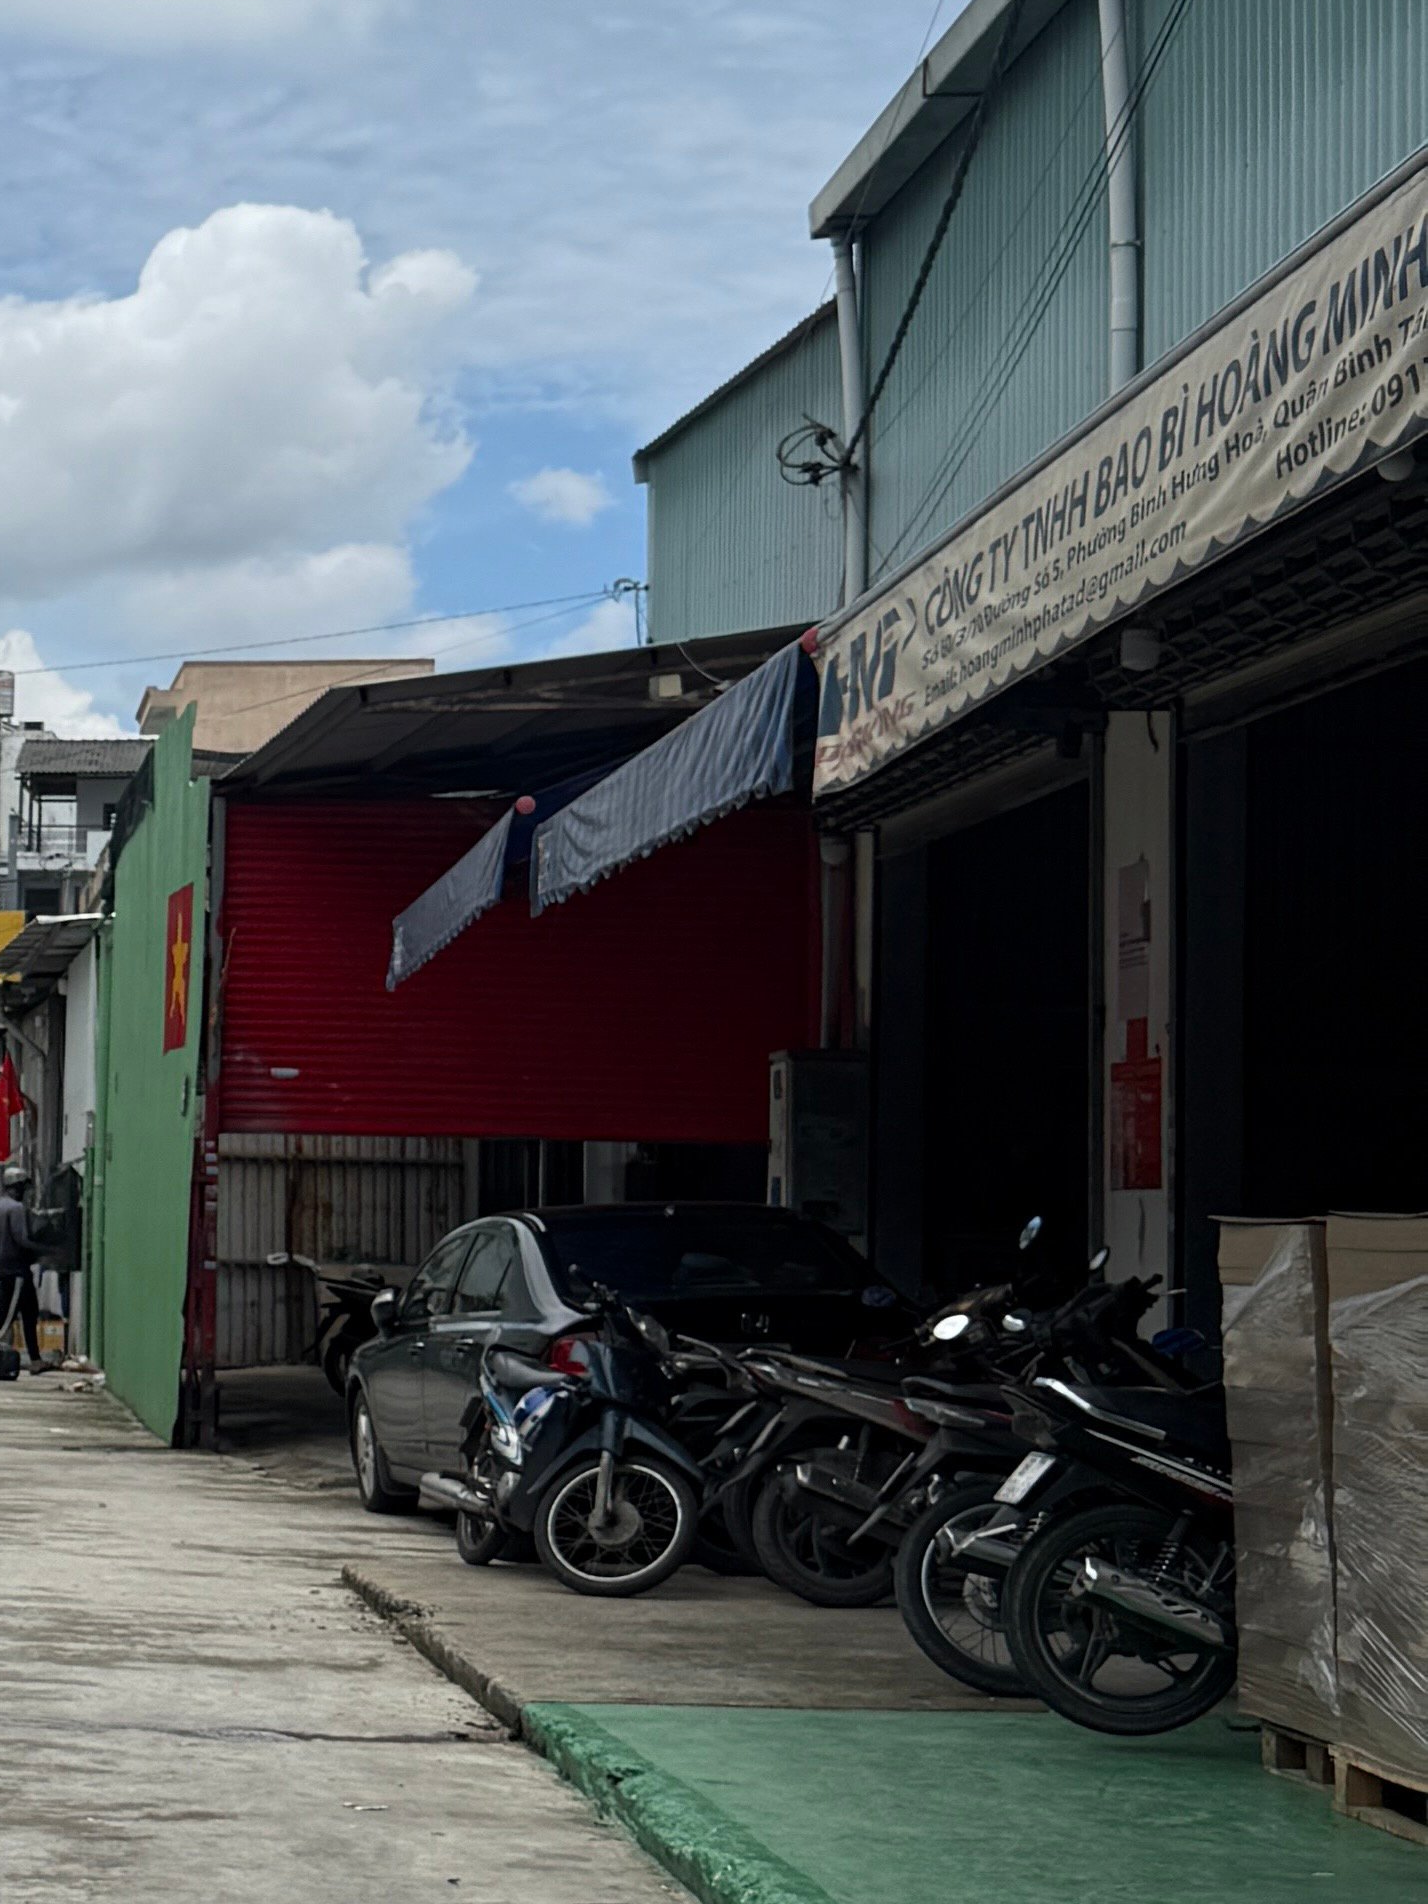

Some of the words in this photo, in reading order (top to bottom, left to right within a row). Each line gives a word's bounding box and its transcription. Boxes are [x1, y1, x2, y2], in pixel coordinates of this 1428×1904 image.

[925, 551, 984, 636] CÔNG
[989, 525, 1019, 593] TY
[1022, 470, 1090, 570] TNHH
[1094, 426, 1152, 519] BAO
[1158, 383, 1190, 473] BÌ
[1194, 300, 1317, 446] HOÀNG
[1322, 210, 1428, 356] MINH
[1034, 565, 1050, 596] Số
[1053, 558, 1064, 580] 5,
[1068, 516, 1126, 571] Phường
[1130, 485, 1166, 529] Bình
[1172, 452, 1220, 500] Hưng
[1333, 334, 1392, 389] Bình
[1276, 402, 1367, 479] Hotline:
